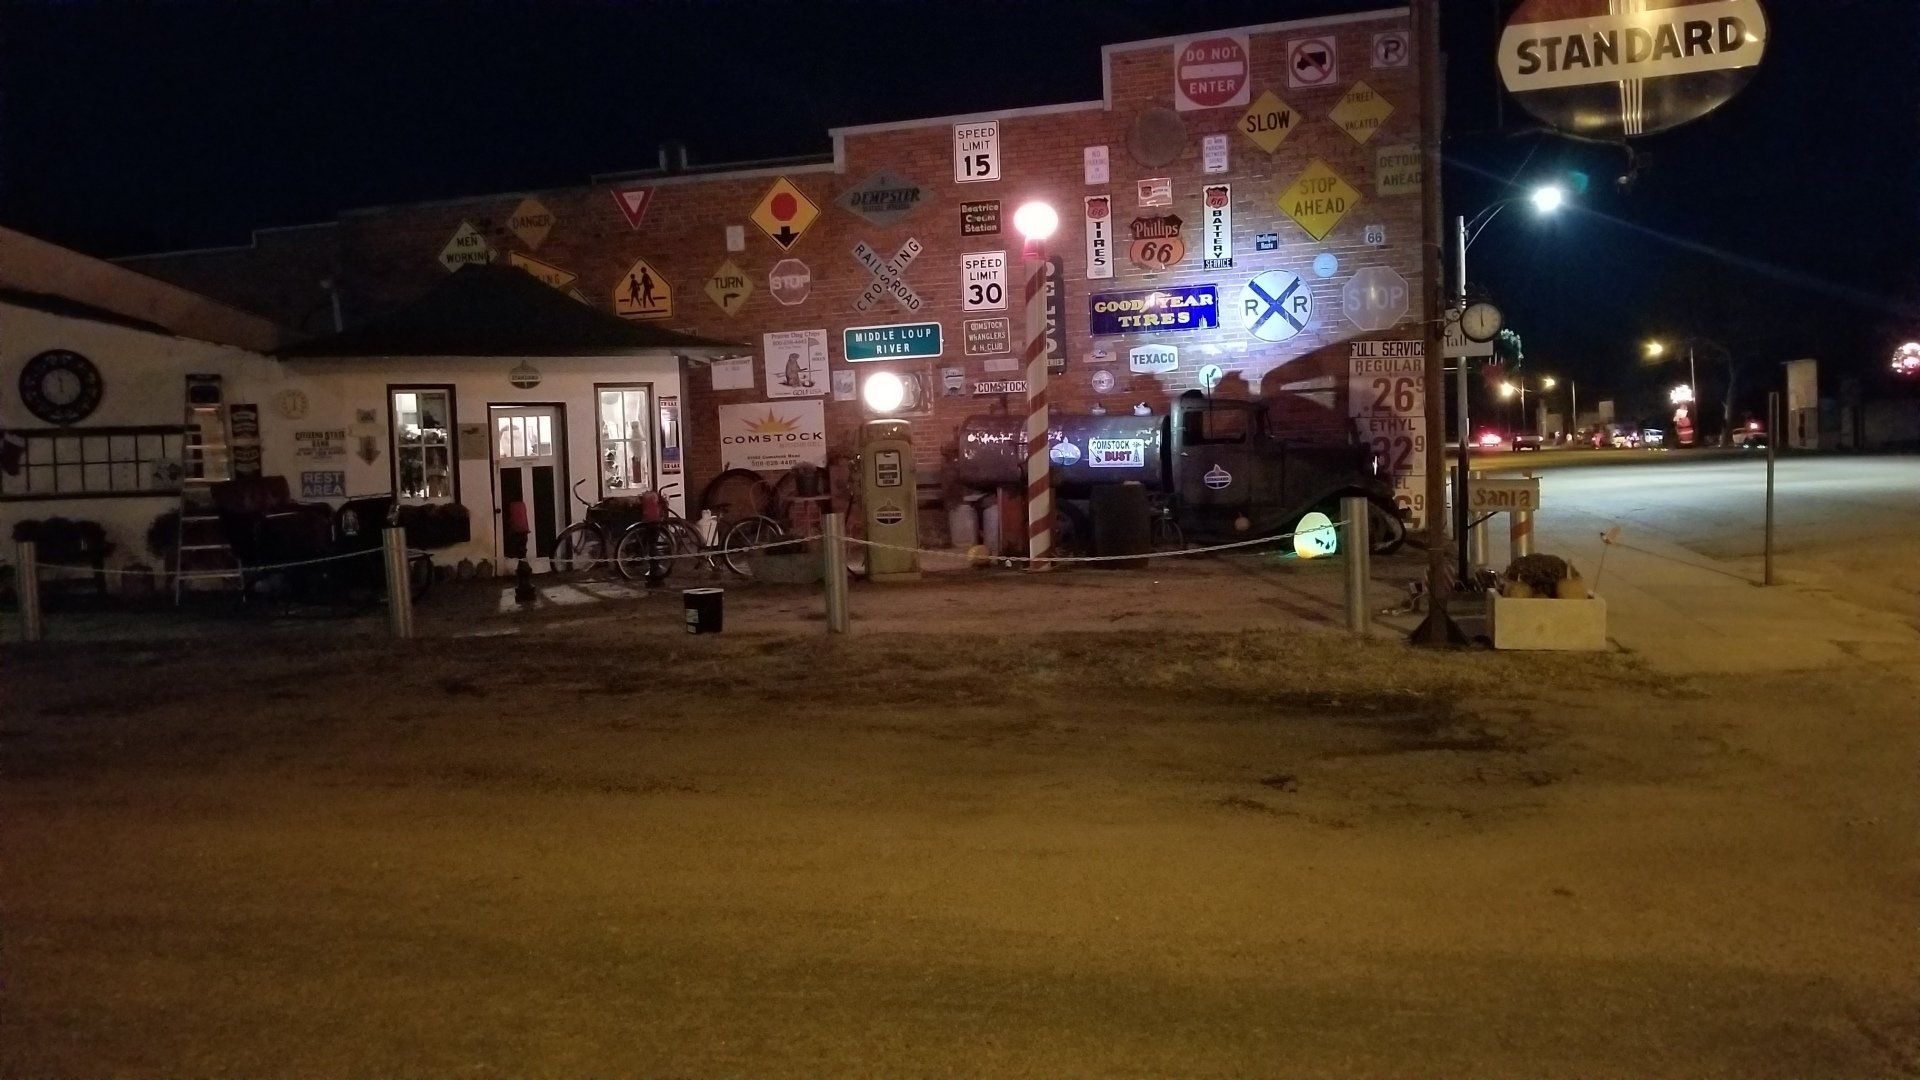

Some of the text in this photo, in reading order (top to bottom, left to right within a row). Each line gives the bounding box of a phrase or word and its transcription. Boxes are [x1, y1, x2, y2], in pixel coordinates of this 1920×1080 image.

[1516, 16, 1747, 75] STANDARD
[1186, 46, 1239, 62] DO NOT
[1189, 80, 1236, 95] ENTER
[1246, 110, 1291, 133] SLOW
[957, 127, 996, 139] SPEED
[962, 140, 991, 151] LIMIT
[964, 153, 991, 177] 15
[1299, 177, 1337, 196] STOP
[961, 203, 999, 213] Beatrice
[1211, 197, 1224, 206] 66
[1294, 197, 1346, 218] AHEAD
[1092, 208, 1104, 216] 66
[512, 214, 550, 229] DANGER
[964, 223, 997, 233] Station
[1135, 221, 1179, 238] Phillips
[1212, 210, 1223, 258] BATTERY
[456, 235, 478, 247] MEN
[1093, 221, 1106, 266] TIRES
[1367, 232, 1382, 243] 66
[446, 251, 490, 263] WORKING
[1141, 241, 1174, 263] 66
[965, 258, 1002, 269] SPEED
[1204, 258, 1232, 269] SERVICE
[713, 275, 744, 289] TURN
[854, 244, 920, 311] RAILROAD
[856, 240, 920, 312] CROSSING
[969, 270, 998, 281] LIMIT
[773, 275, 810, 291] STOP
[968, 283, 1003, 306] 30
[1348, 286, 1404, 311] STOP
[1245, 295, 1308, 317] R R
[970, 320, 1003, 332] COMSTOCK
[1118, 312, 1190, 328] TIRES
[855, 328, 932, 342] MIDDLE LOUP
[876, 343, 910, 354] RIVER
[1350, 342, 1376, 357] FULL
[1132, 352, 1176, 365] TEXACO
[1355, 358, 1422, 374] REGULAR
[978, 381, 1028, 393] COMSTOCK
[1369, 418, 1416, 432] ETHYL
[722, 432, 823, 445] COMSTOCK
[1092, 440, 1130, 450] COMSTOCK
[303, 472, 342, 483] REST
[303, 484, 342, 496] AREA
